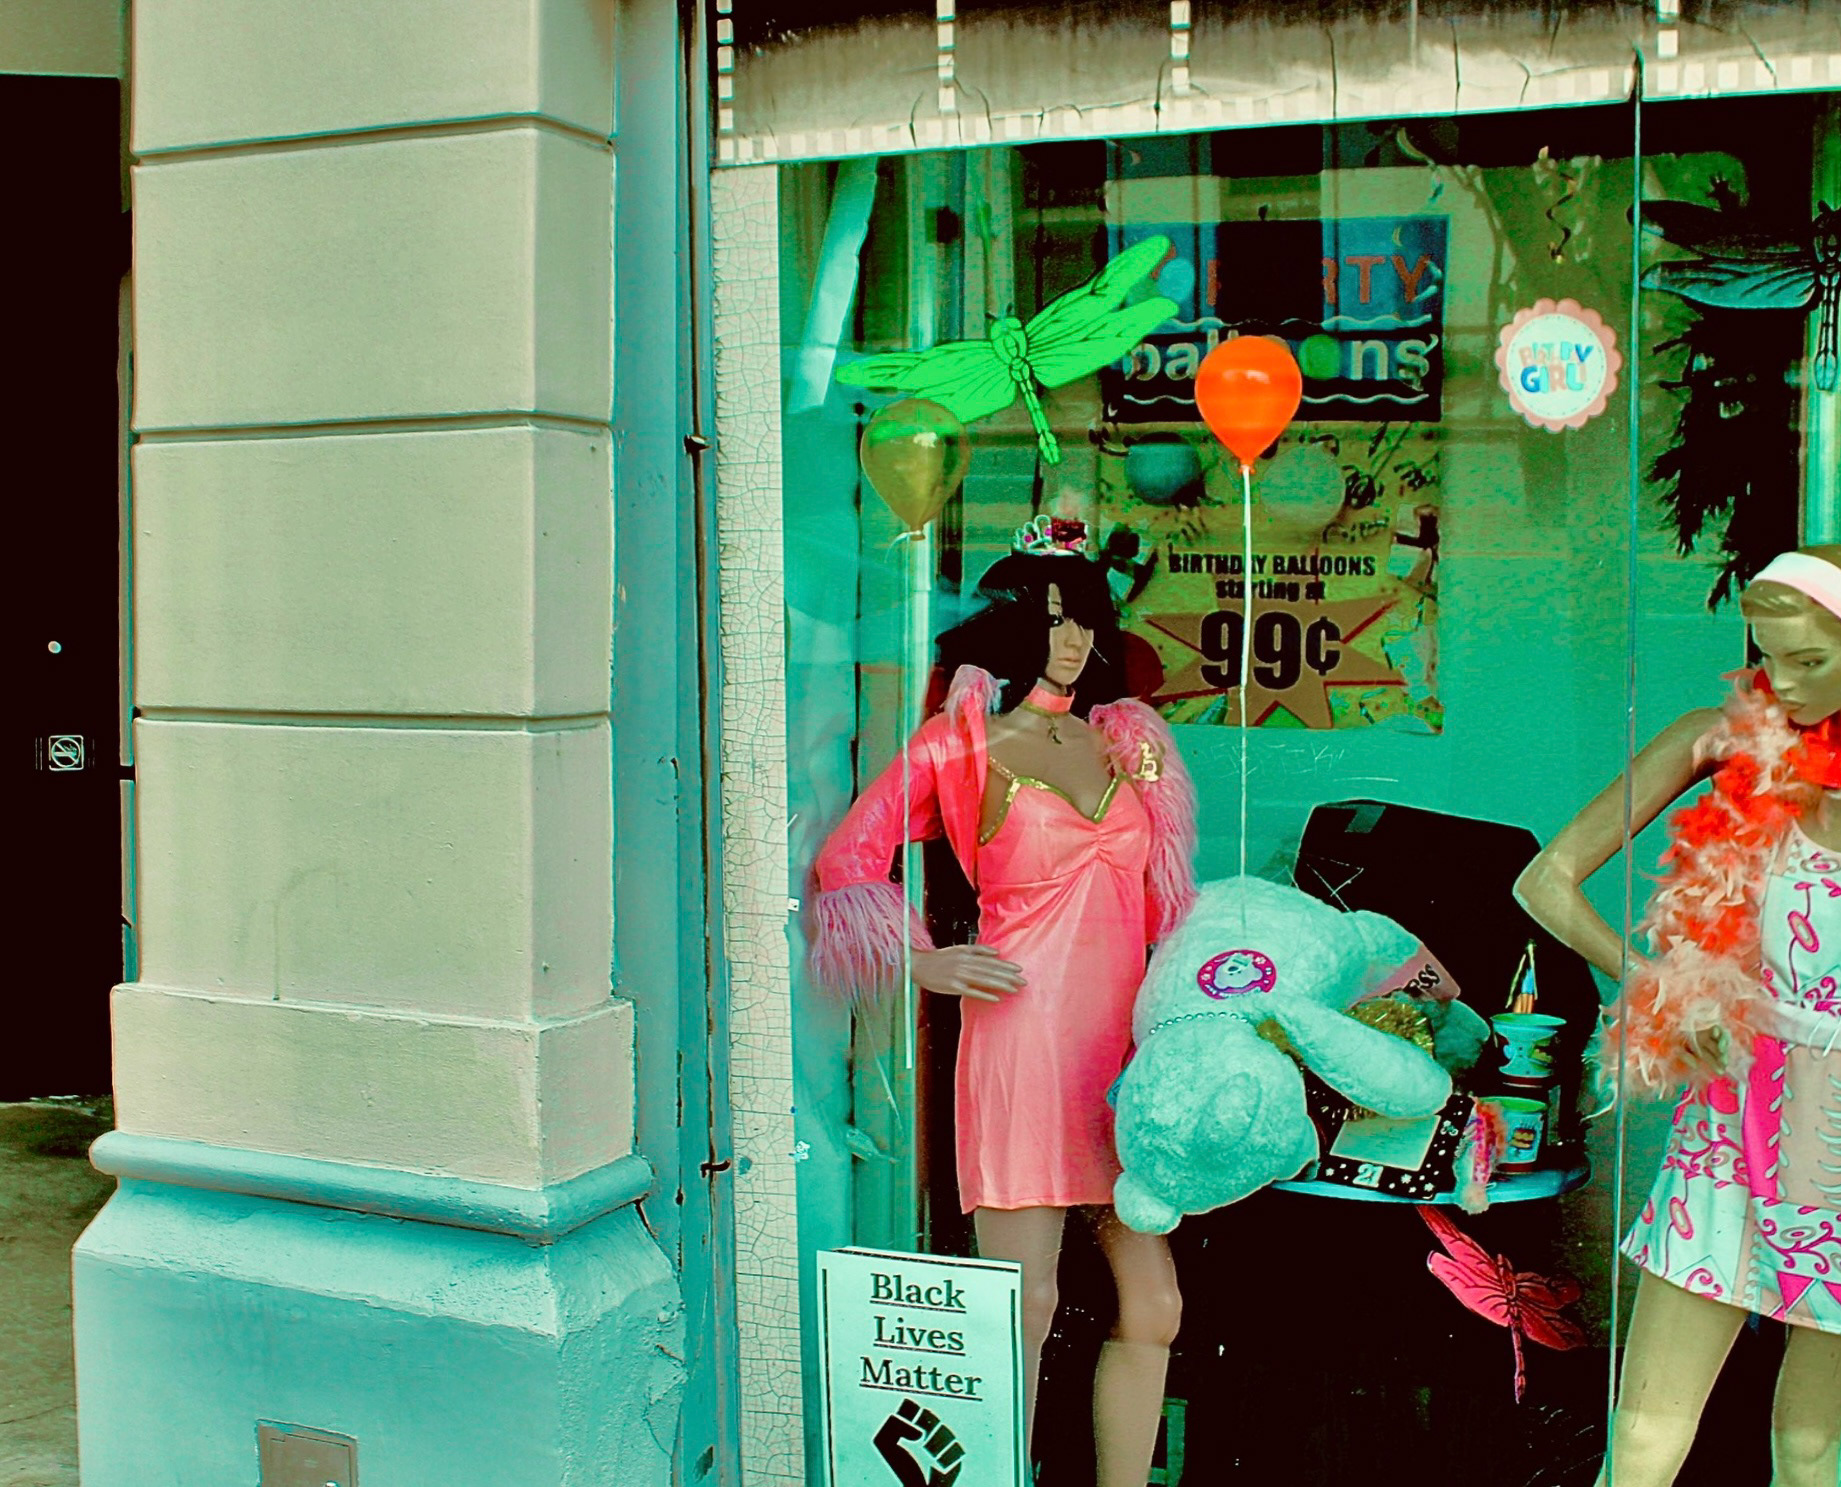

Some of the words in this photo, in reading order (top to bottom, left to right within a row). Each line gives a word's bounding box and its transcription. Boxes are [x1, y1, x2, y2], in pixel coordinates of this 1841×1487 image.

[1273, 555, 1376, 576] BALLOONS
[1201, 610, 1341, 690] 99¢
[1353, 1161, 1384, 1188] 21
[870, 1272, 966, 1309] Black
[873, 1315, 965, 1351] Lives
[860, 1356, 982, 1396] Matter
